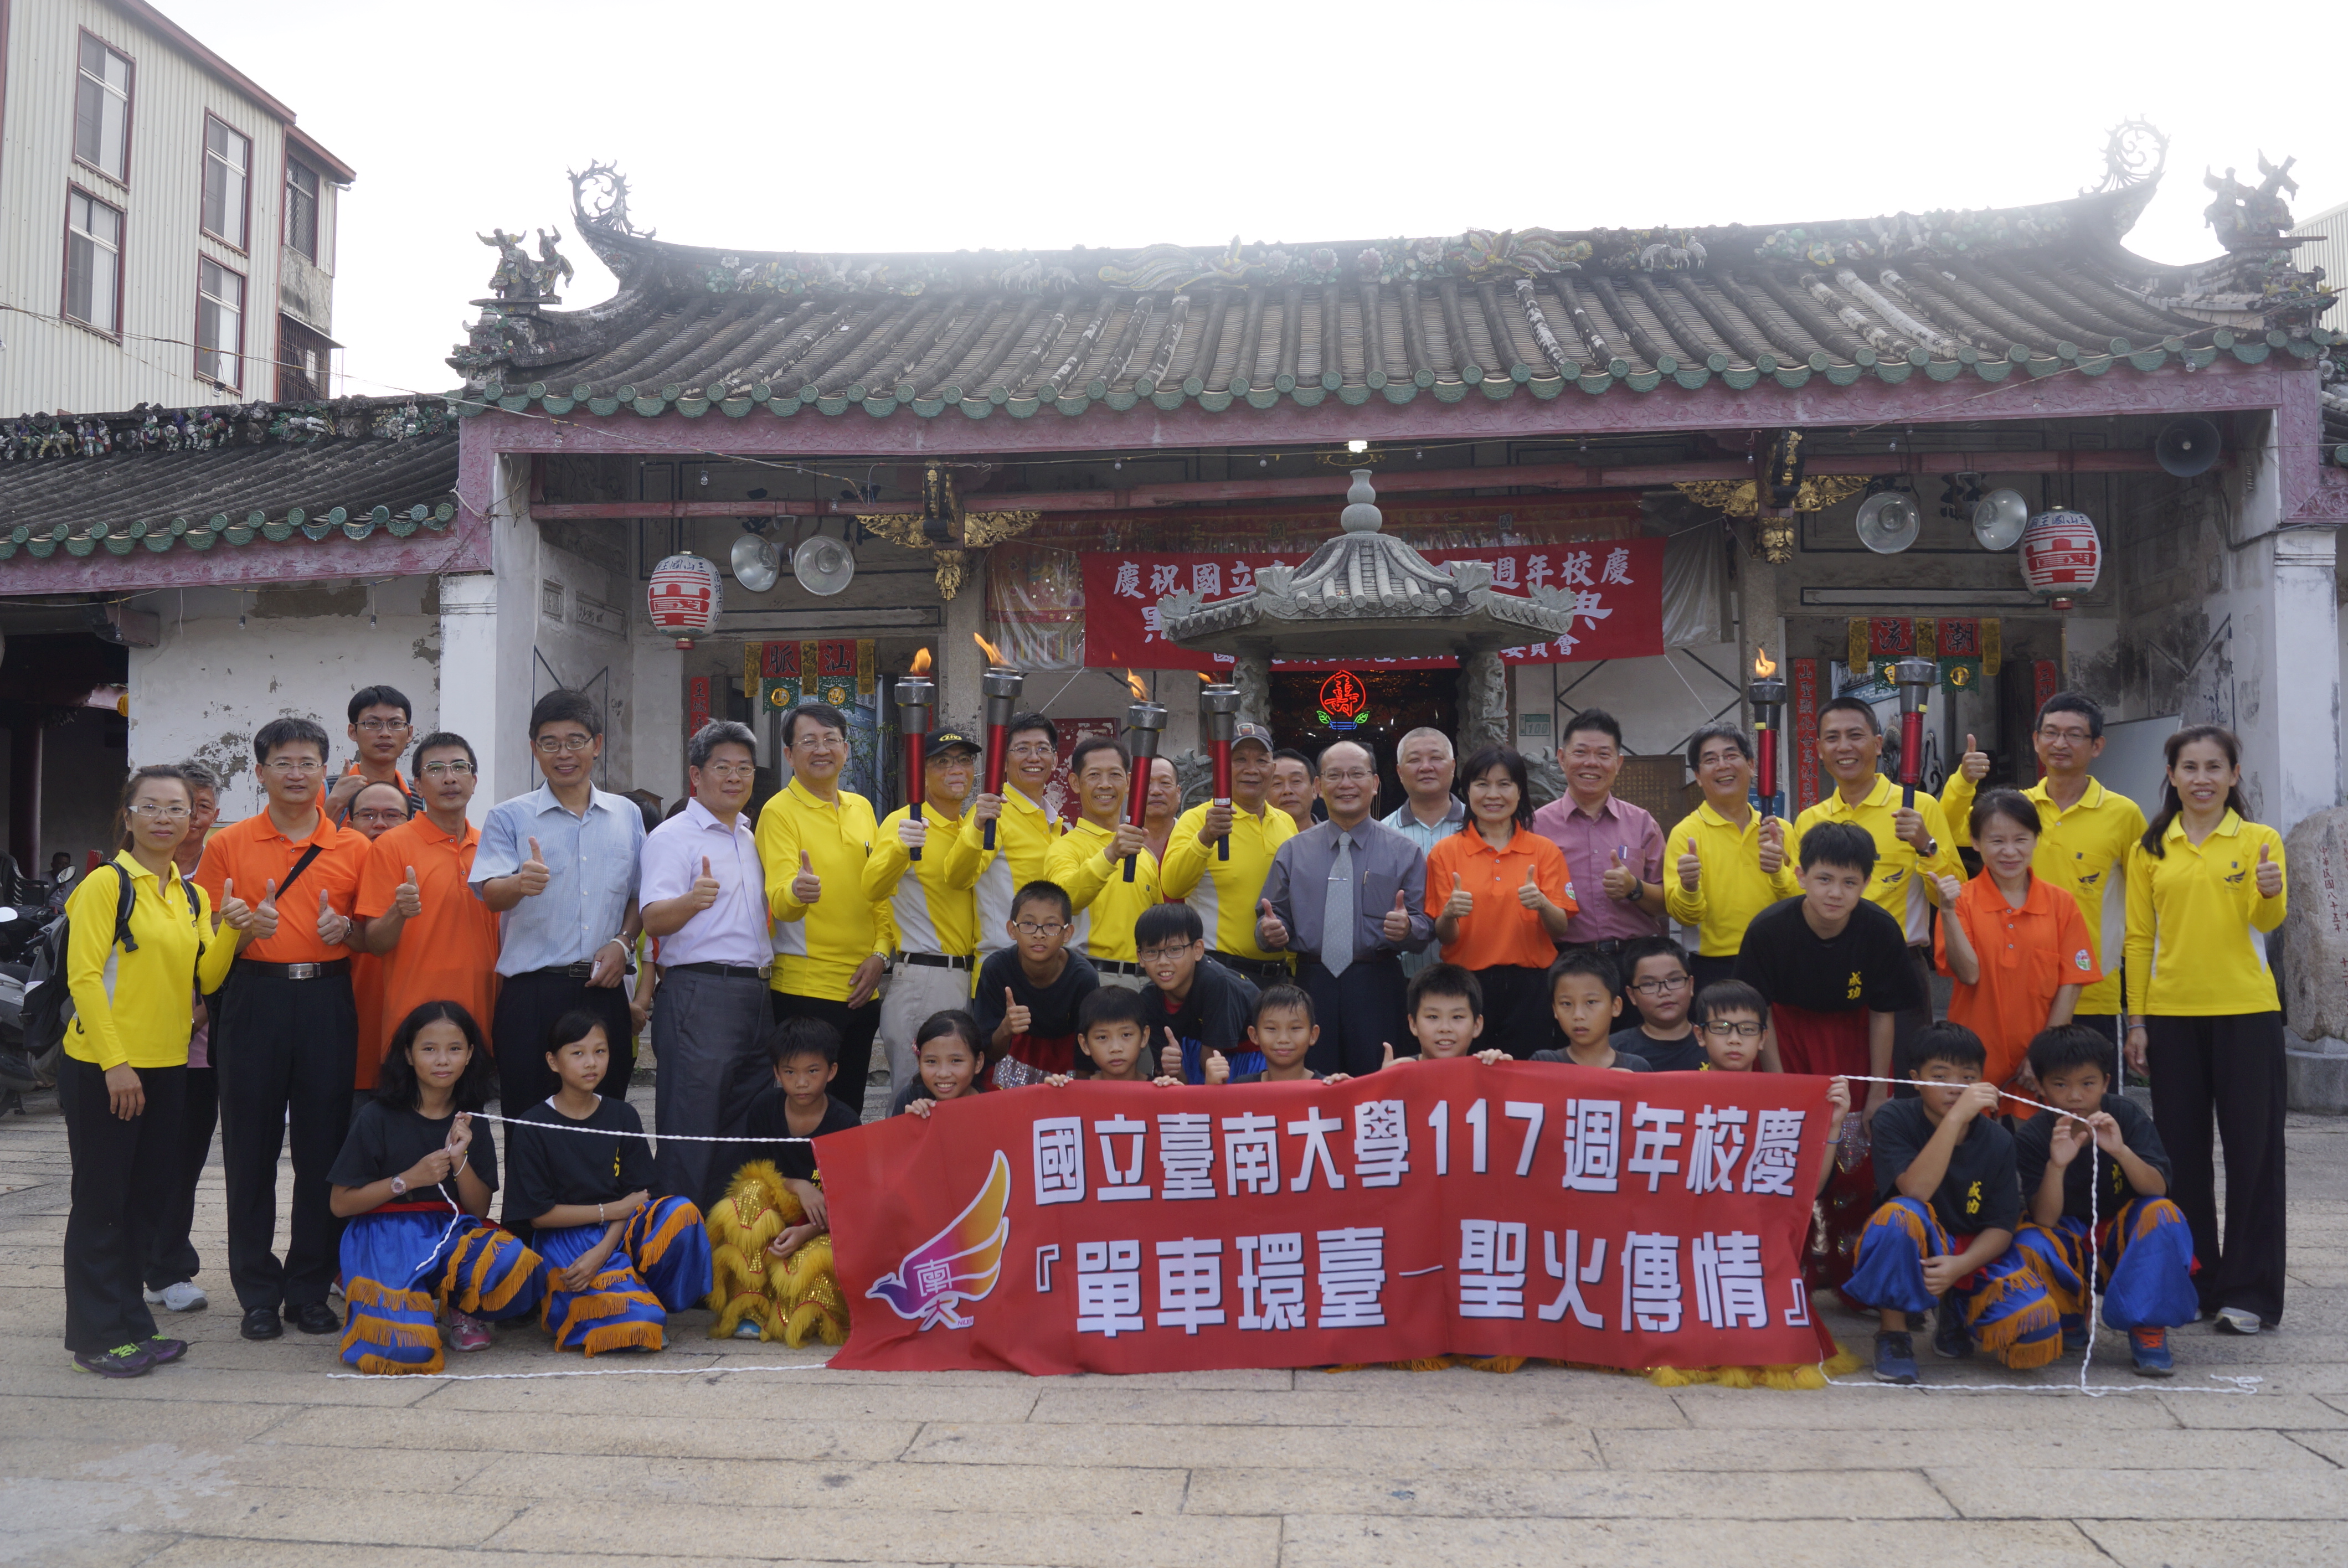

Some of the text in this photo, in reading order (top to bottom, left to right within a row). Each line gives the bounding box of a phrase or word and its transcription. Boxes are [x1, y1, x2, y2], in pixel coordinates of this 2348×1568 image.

[1033, 1098, 1806, 1205] 國立臺南大學117週年校慶
